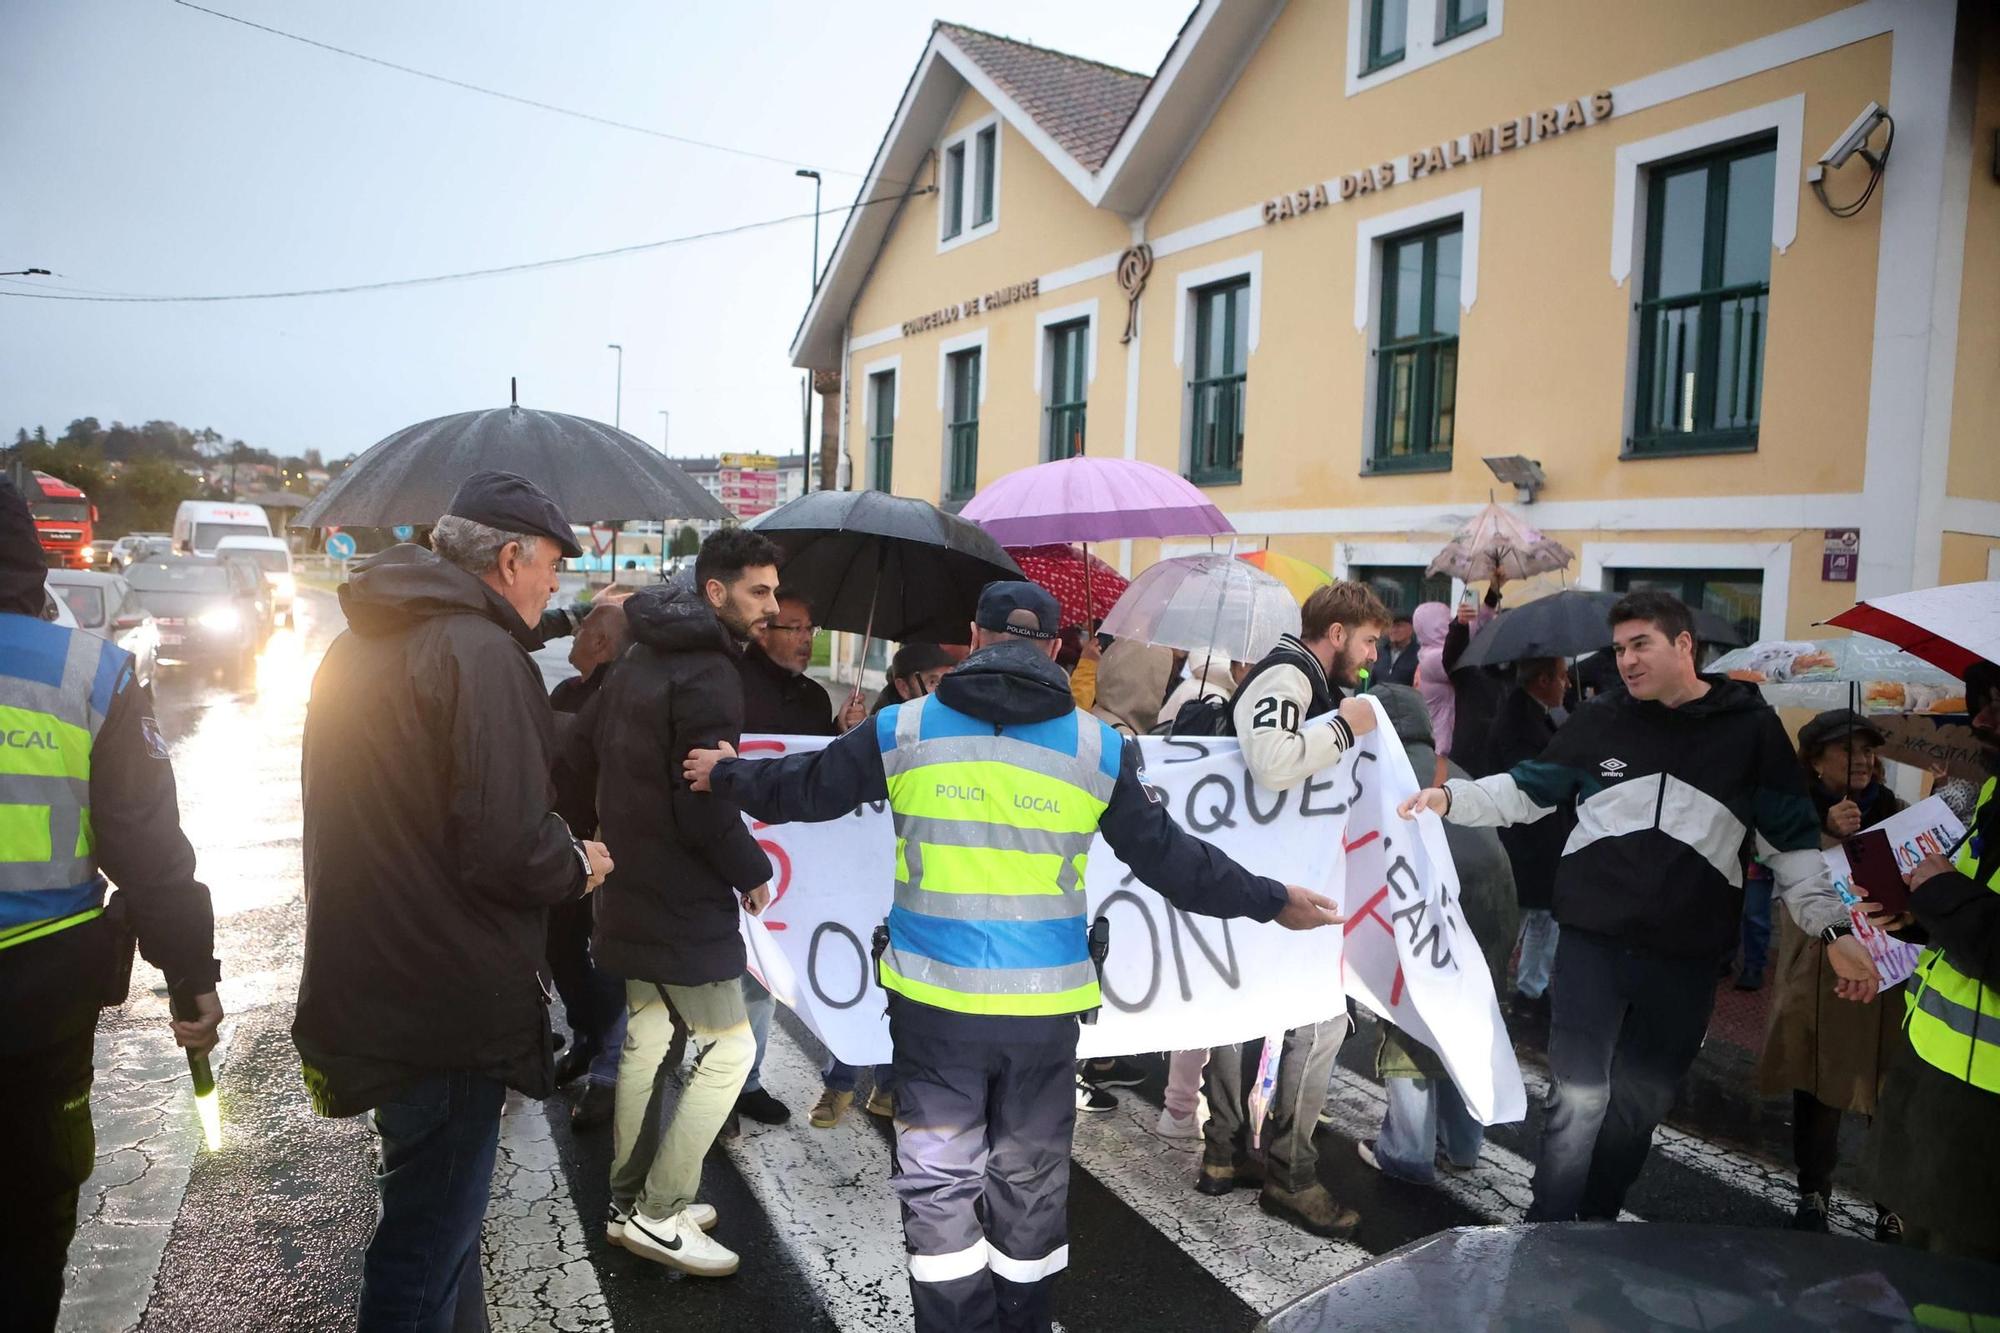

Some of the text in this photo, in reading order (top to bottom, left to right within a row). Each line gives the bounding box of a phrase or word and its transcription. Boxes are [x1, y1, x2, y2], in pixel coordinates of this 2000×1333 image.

[1261, 90, 1614, 223] CASA DAS PALMEIRAS
[902, 279, 1039, 337] CONCELLO DE CAMBRE
[1253, 697, 1300, 735] 20
[1601, 770, 1624, 778] umbro
[1014, 793, 1061, 814] LOCAL
